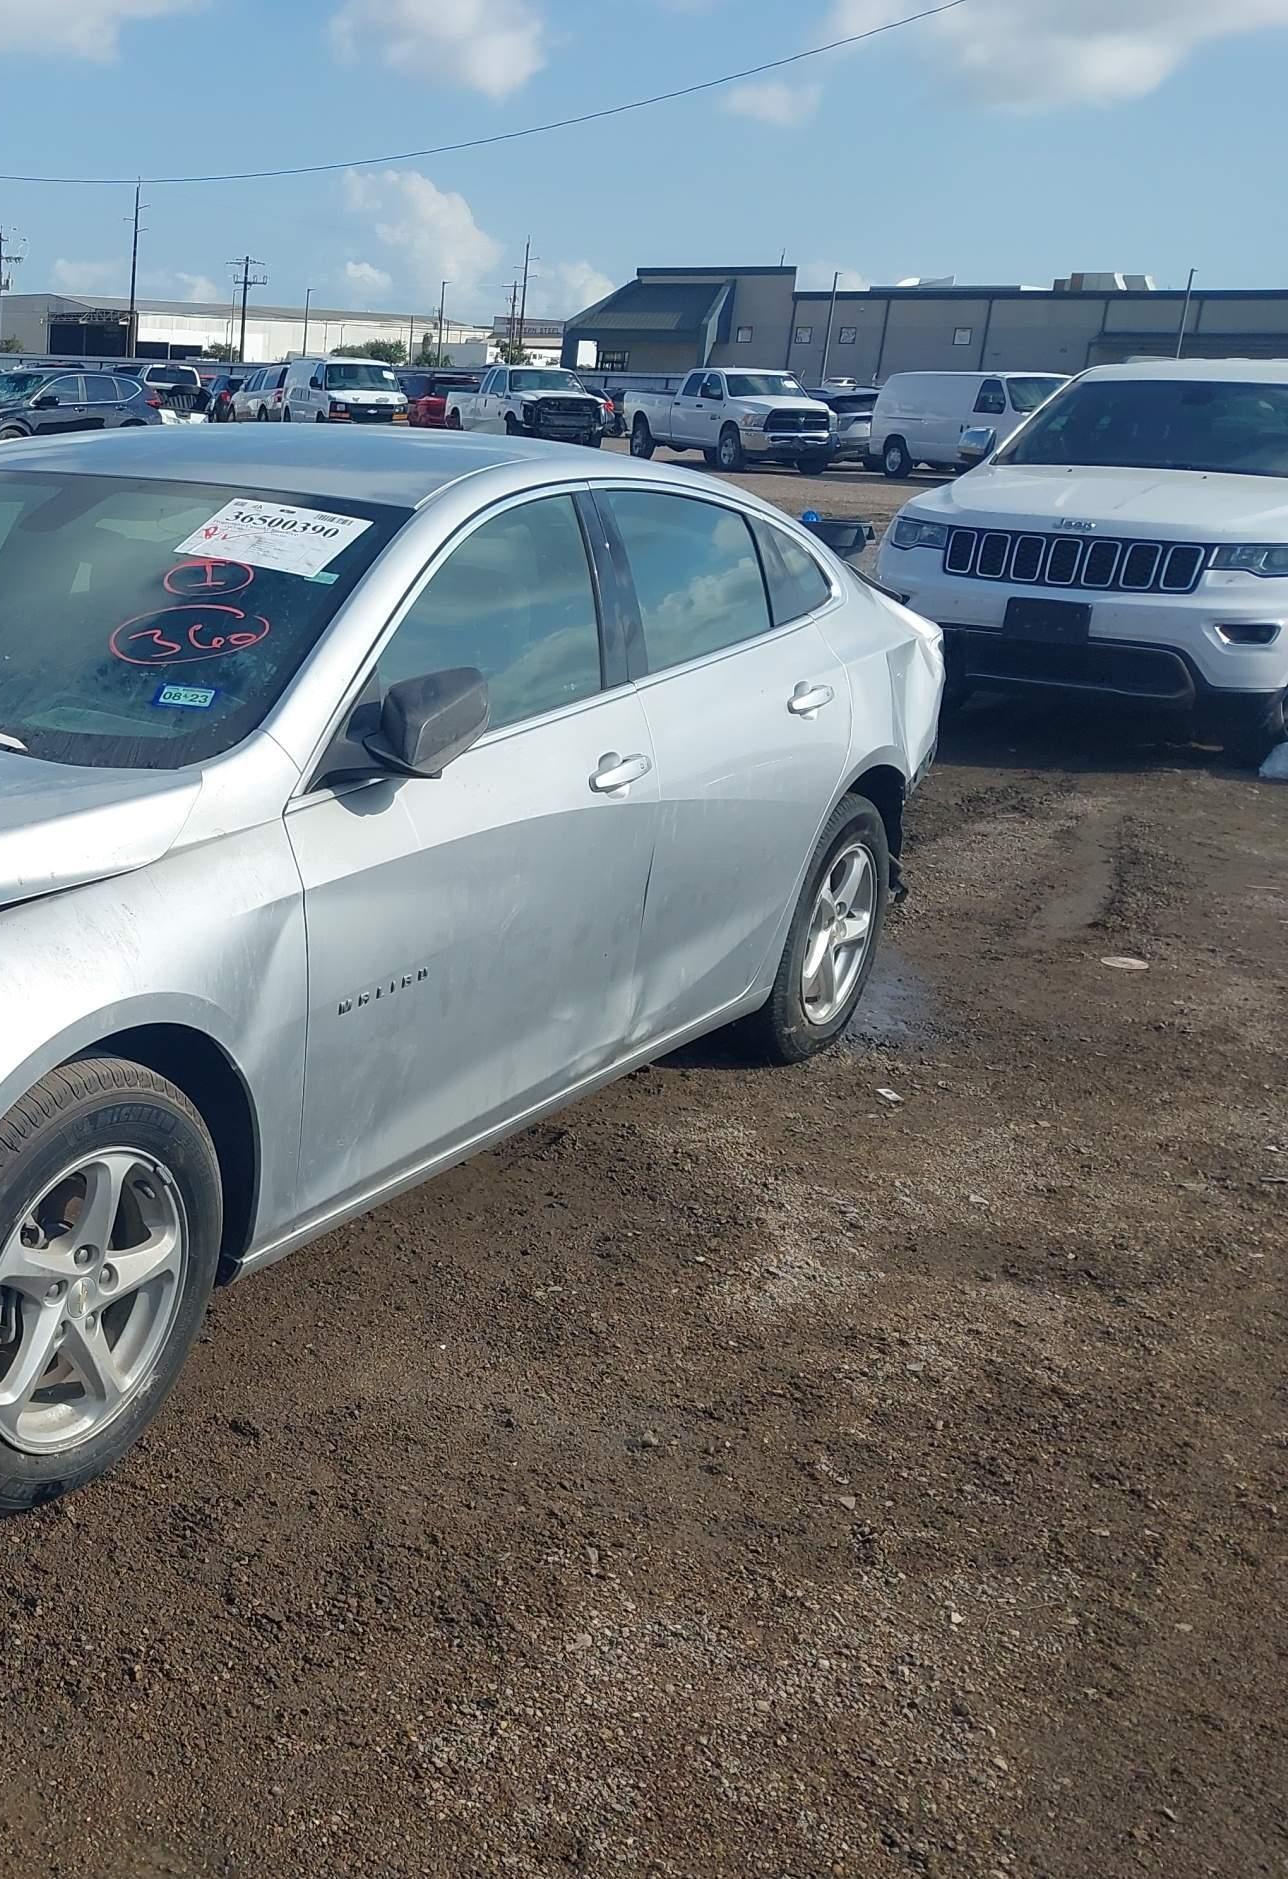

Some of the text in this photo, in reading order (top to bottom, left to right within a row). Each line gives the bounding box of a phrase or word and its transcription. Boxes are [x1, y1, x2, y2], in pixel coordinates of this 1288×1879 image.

[540, 327, 561, 335] STEEL
[225, 510, 340, 540] 36500390
[128, 623, 257, 658] 360
[162, 691, 209, 704] 08 23
[95, 1106, 177, 1134] MICHELIN
